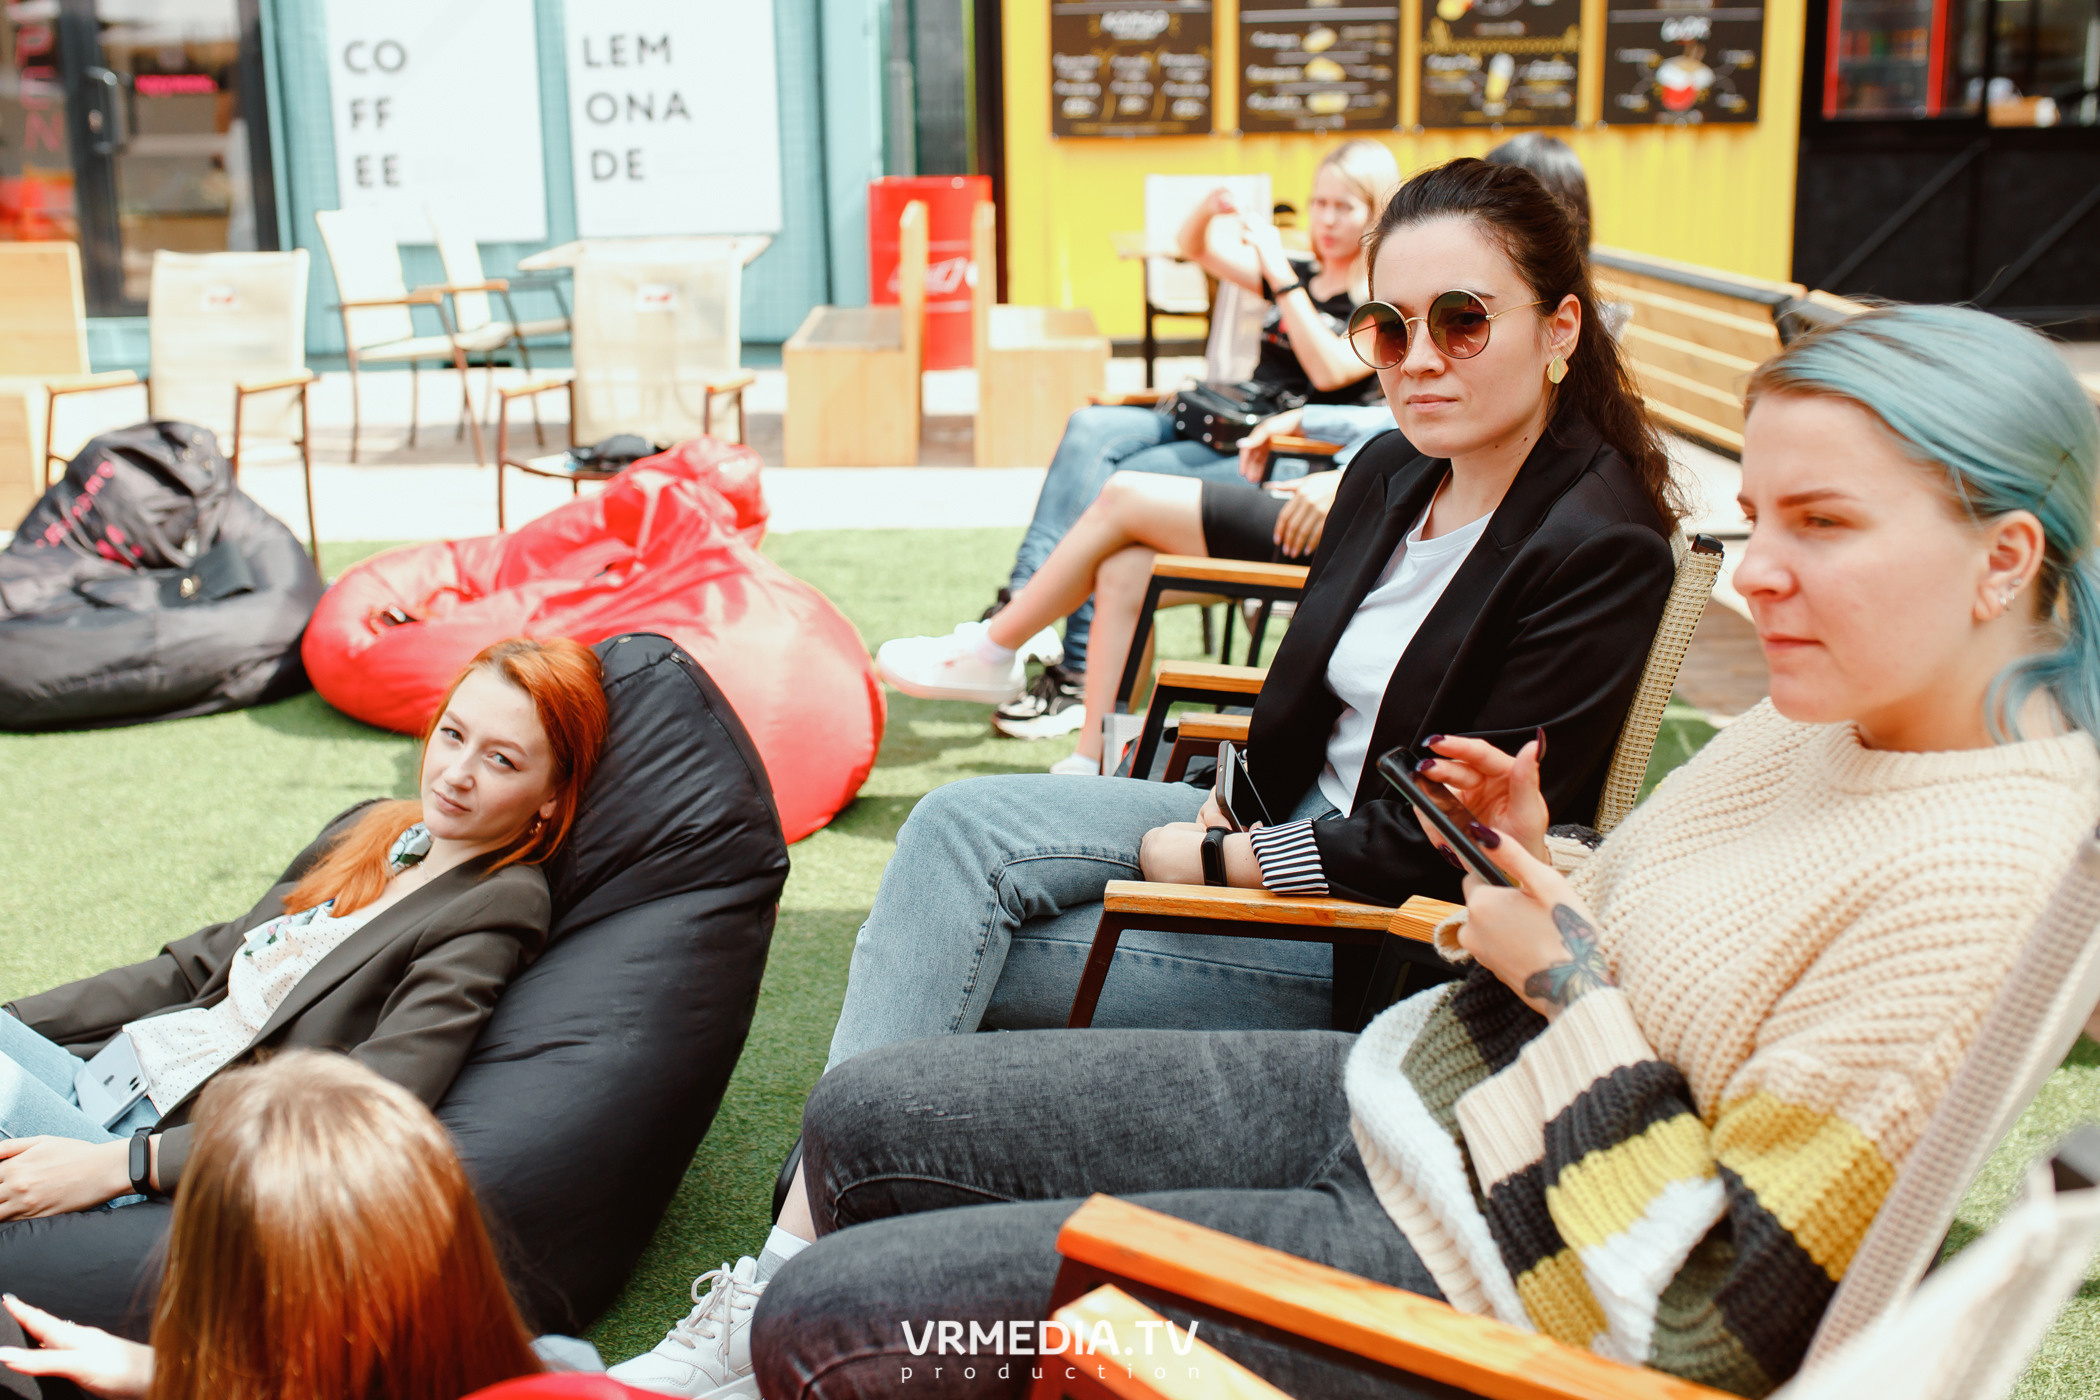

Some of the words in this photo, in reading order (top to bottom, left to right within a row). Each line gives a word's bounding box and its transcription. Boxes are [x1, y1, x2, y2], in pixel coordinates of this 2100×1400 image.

[344, 40, 407, 75] CO
[583, 34, 672, 68] LEM
[351, 98, 391, 129] FF
[586, 92, 690, 125] ONA
[355, 155, 400, 188] EE
[591, 150, 645, 182] DE
